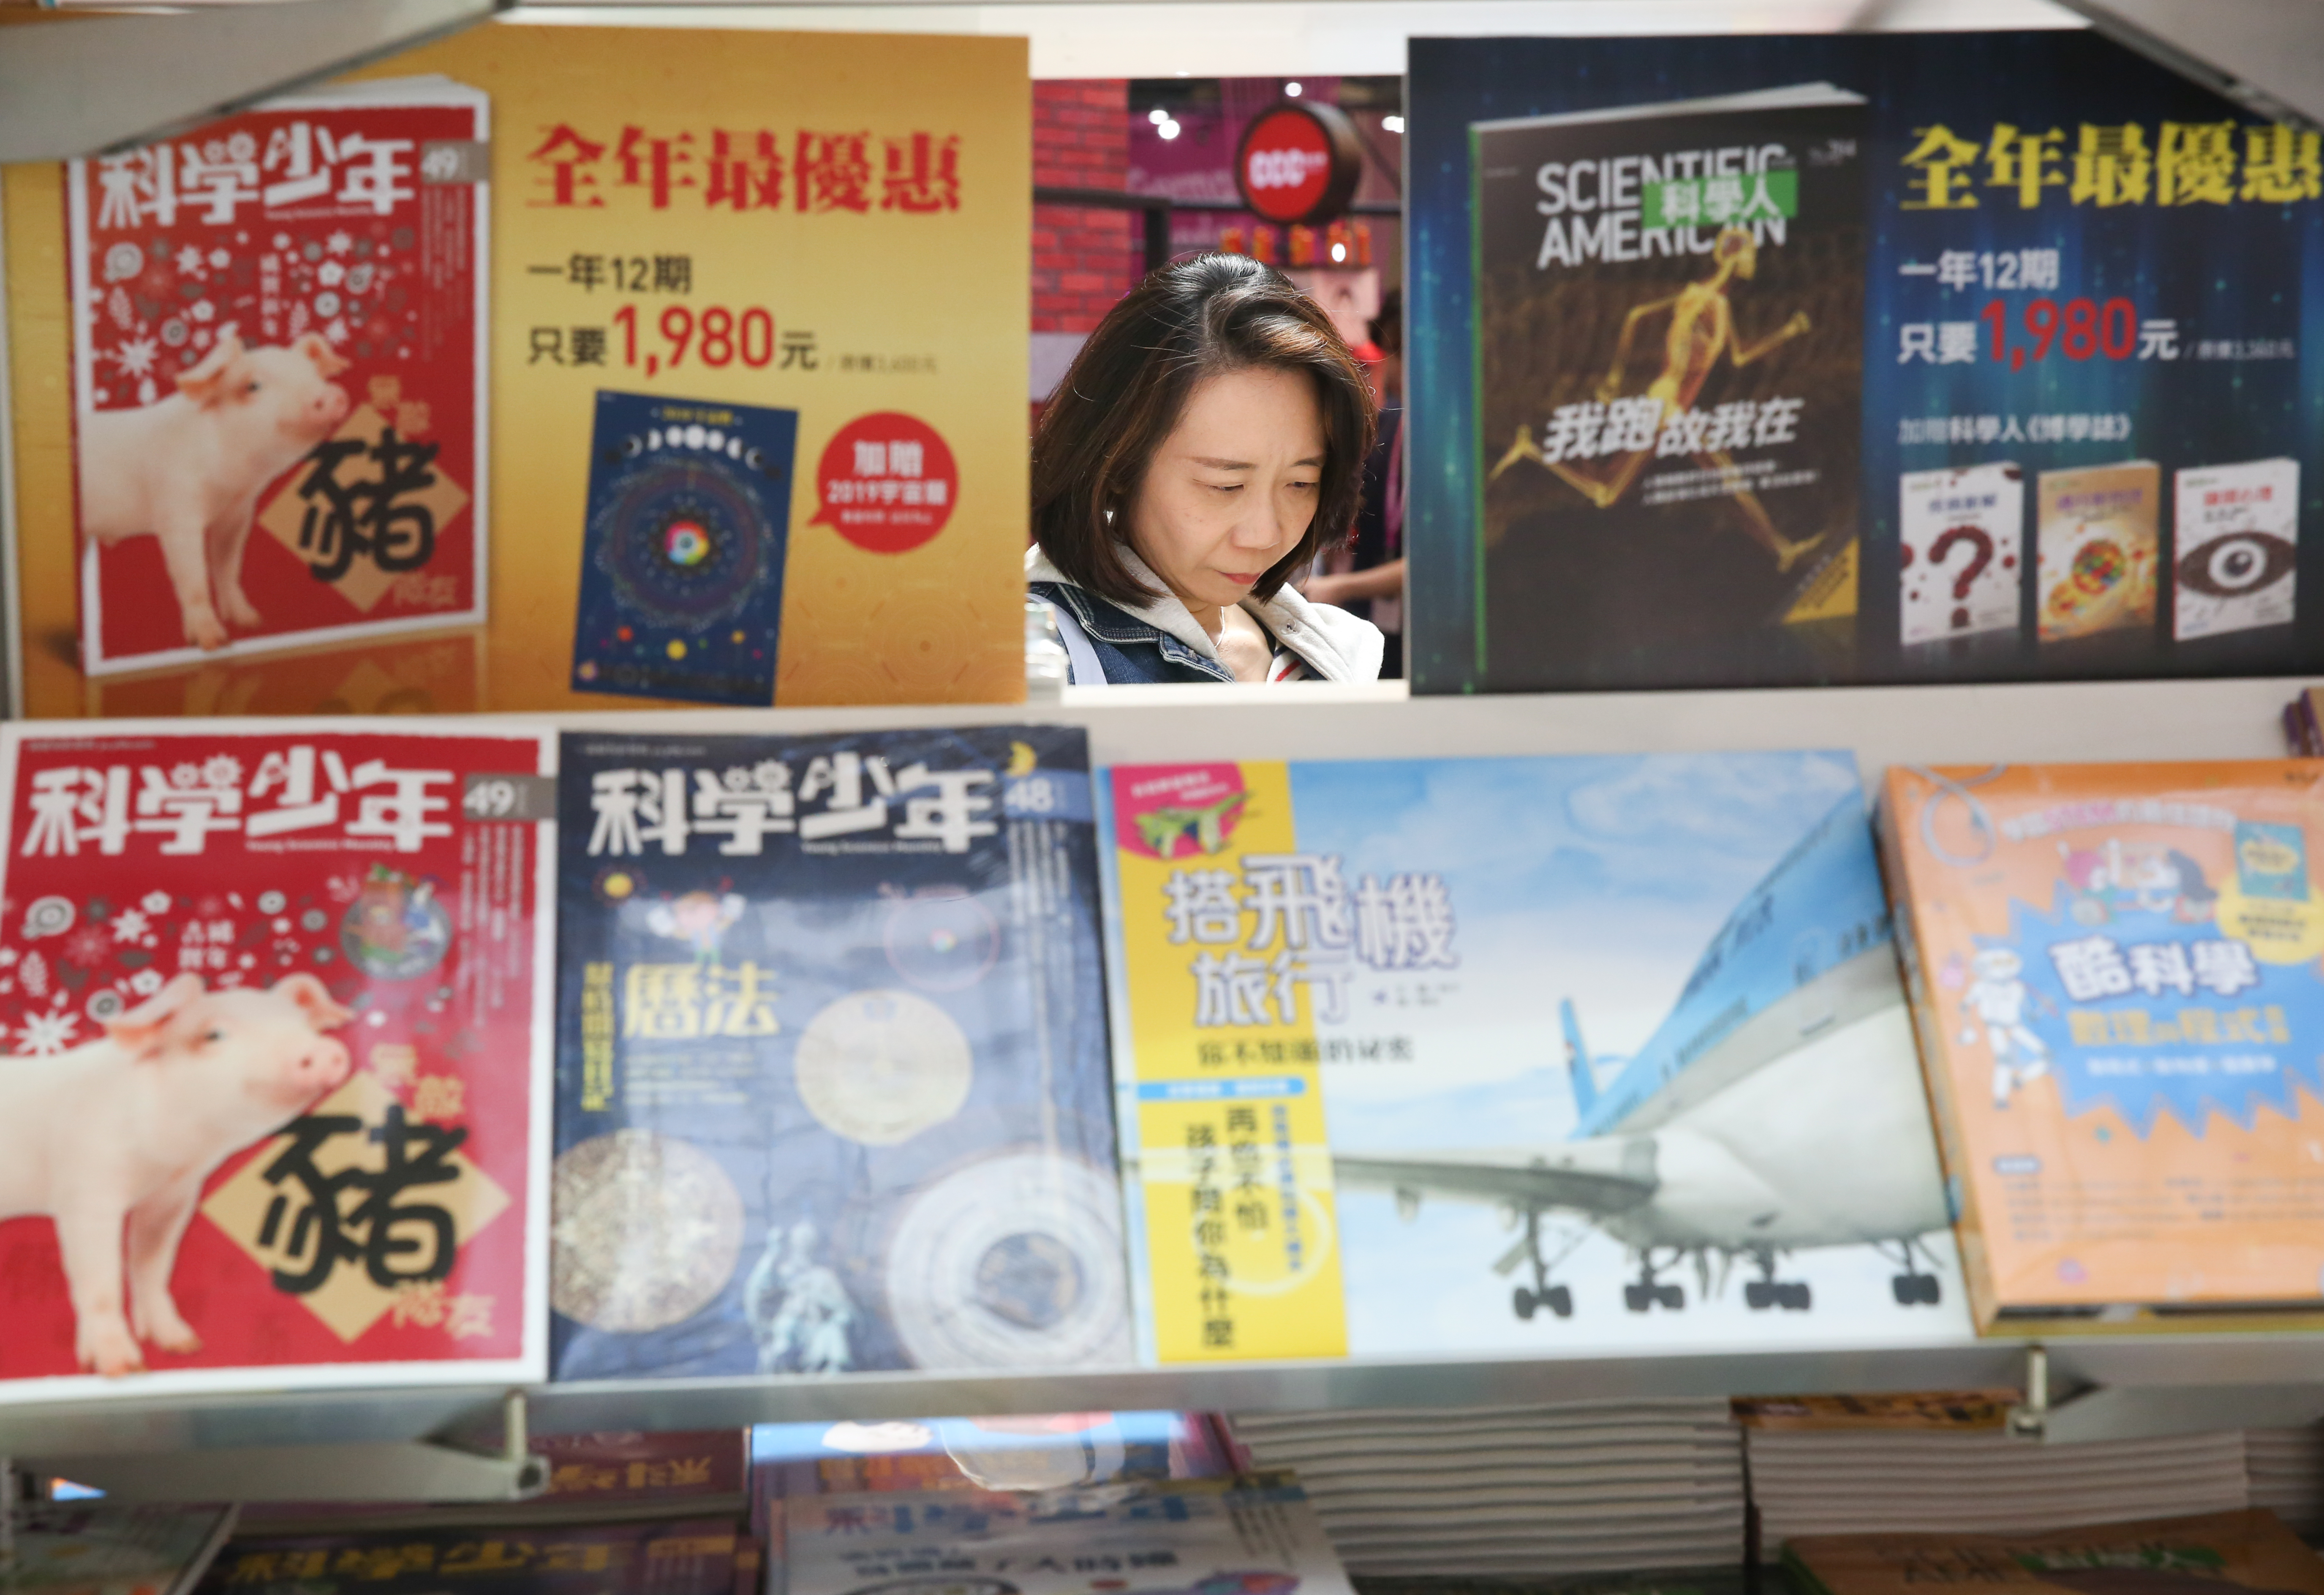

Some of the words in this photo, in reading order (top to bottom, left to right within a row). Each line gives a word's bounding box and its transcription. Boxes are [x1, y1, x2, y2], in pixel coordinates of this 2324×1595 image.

[98, 122, 414, 228] 科學少年
[525, 123, 962, 213] 全年最優惠
[1661, 177, 1781, 226] 科學人
[1899, 119, 2322, 210] 全年最優惠
[526, 253, 693, 295] 一年12期
[1536, 210, 1787, 271] AMERICN
[1898, 249, 2059, 291] 一年12期
[526, 304, 818, 379] 只要1,980元
[1898, 297, 2179, 372] 只要1,980元
[1542, 394, 1806, 465] 我跑故我在
[299, 426, 439, 582] 豬
[20, 745, 455, 856] 科學少年
[463, 780, 515, 817] 49
[586, 751, 998, 856] 科學少年
[1007, 778, 1055, 813] 48
[1162, 853, 1459, 970] 搭飛機
[1190, 949, 1355, 1028] 旅行
[2048, 934, 2259, 1003] 酷科學
[257, 1102, 468, 1296] 豬
[1186, 1124, 1235, 1351] 孩子問你為什麼
